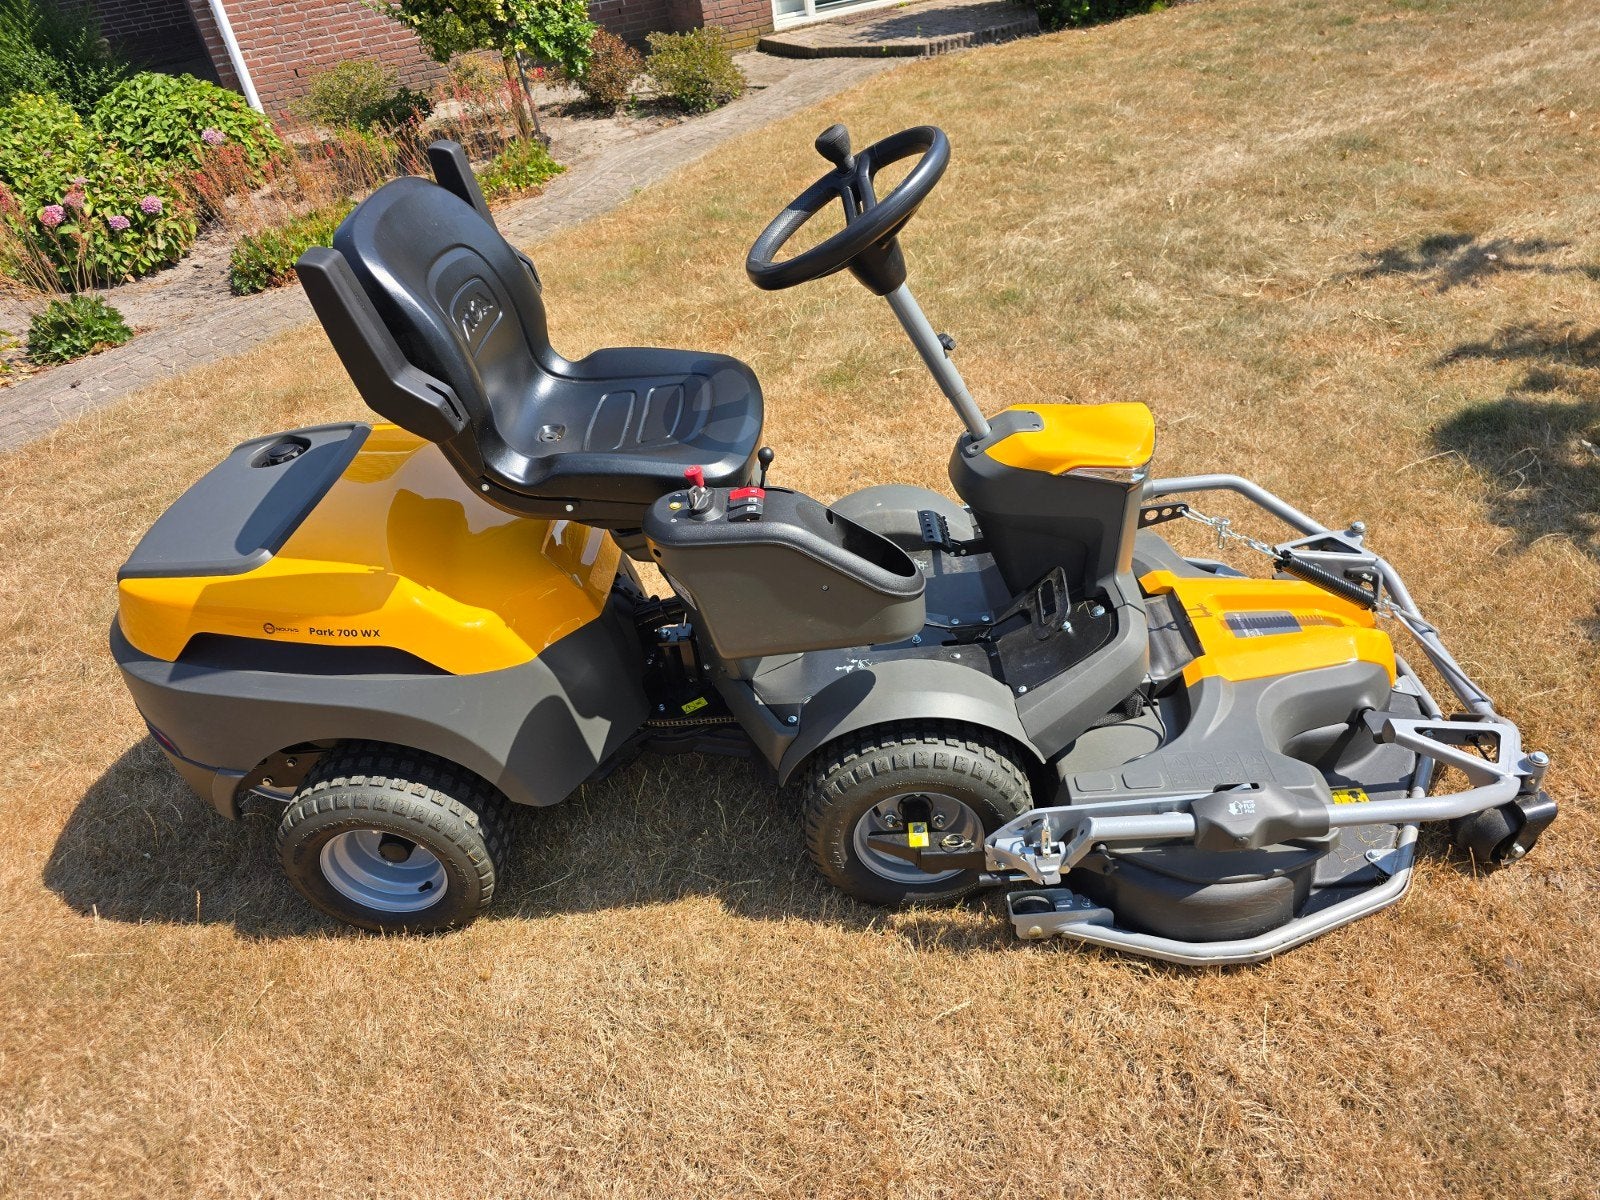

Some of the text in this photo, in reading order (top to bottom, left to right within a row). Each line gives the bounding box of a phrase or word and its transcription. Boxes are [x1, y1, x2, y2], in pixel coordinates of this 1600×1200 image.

[309, 627, 380, 638] Park 700 WX
